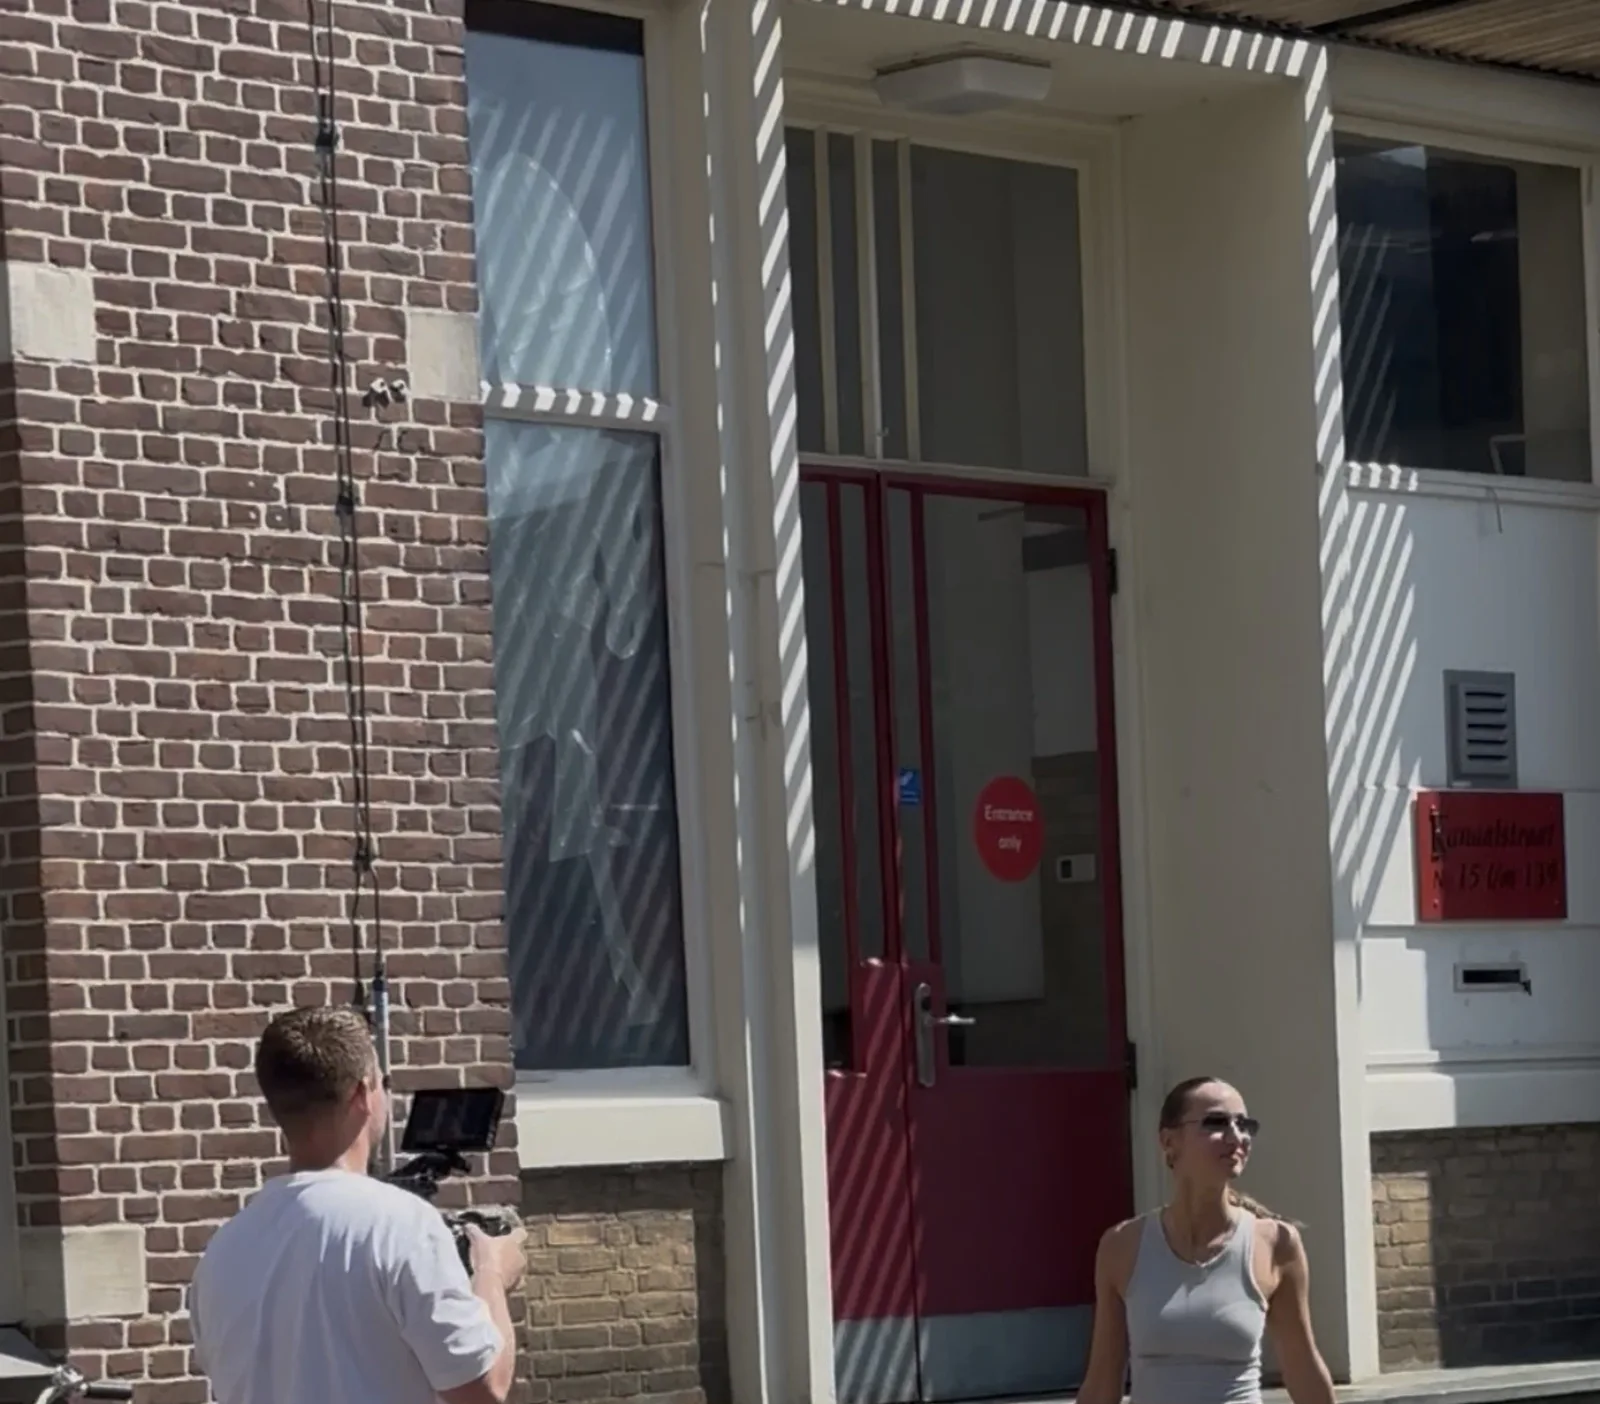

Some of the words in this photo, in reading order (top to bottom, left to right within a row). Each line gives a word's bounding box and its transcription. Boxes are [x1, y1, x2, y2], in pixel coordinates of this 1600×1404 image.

[984, 803, 1034, 822] Entrance
[997, 834, 1022, 853] only
[1460, 862, 1482, 890] 15
